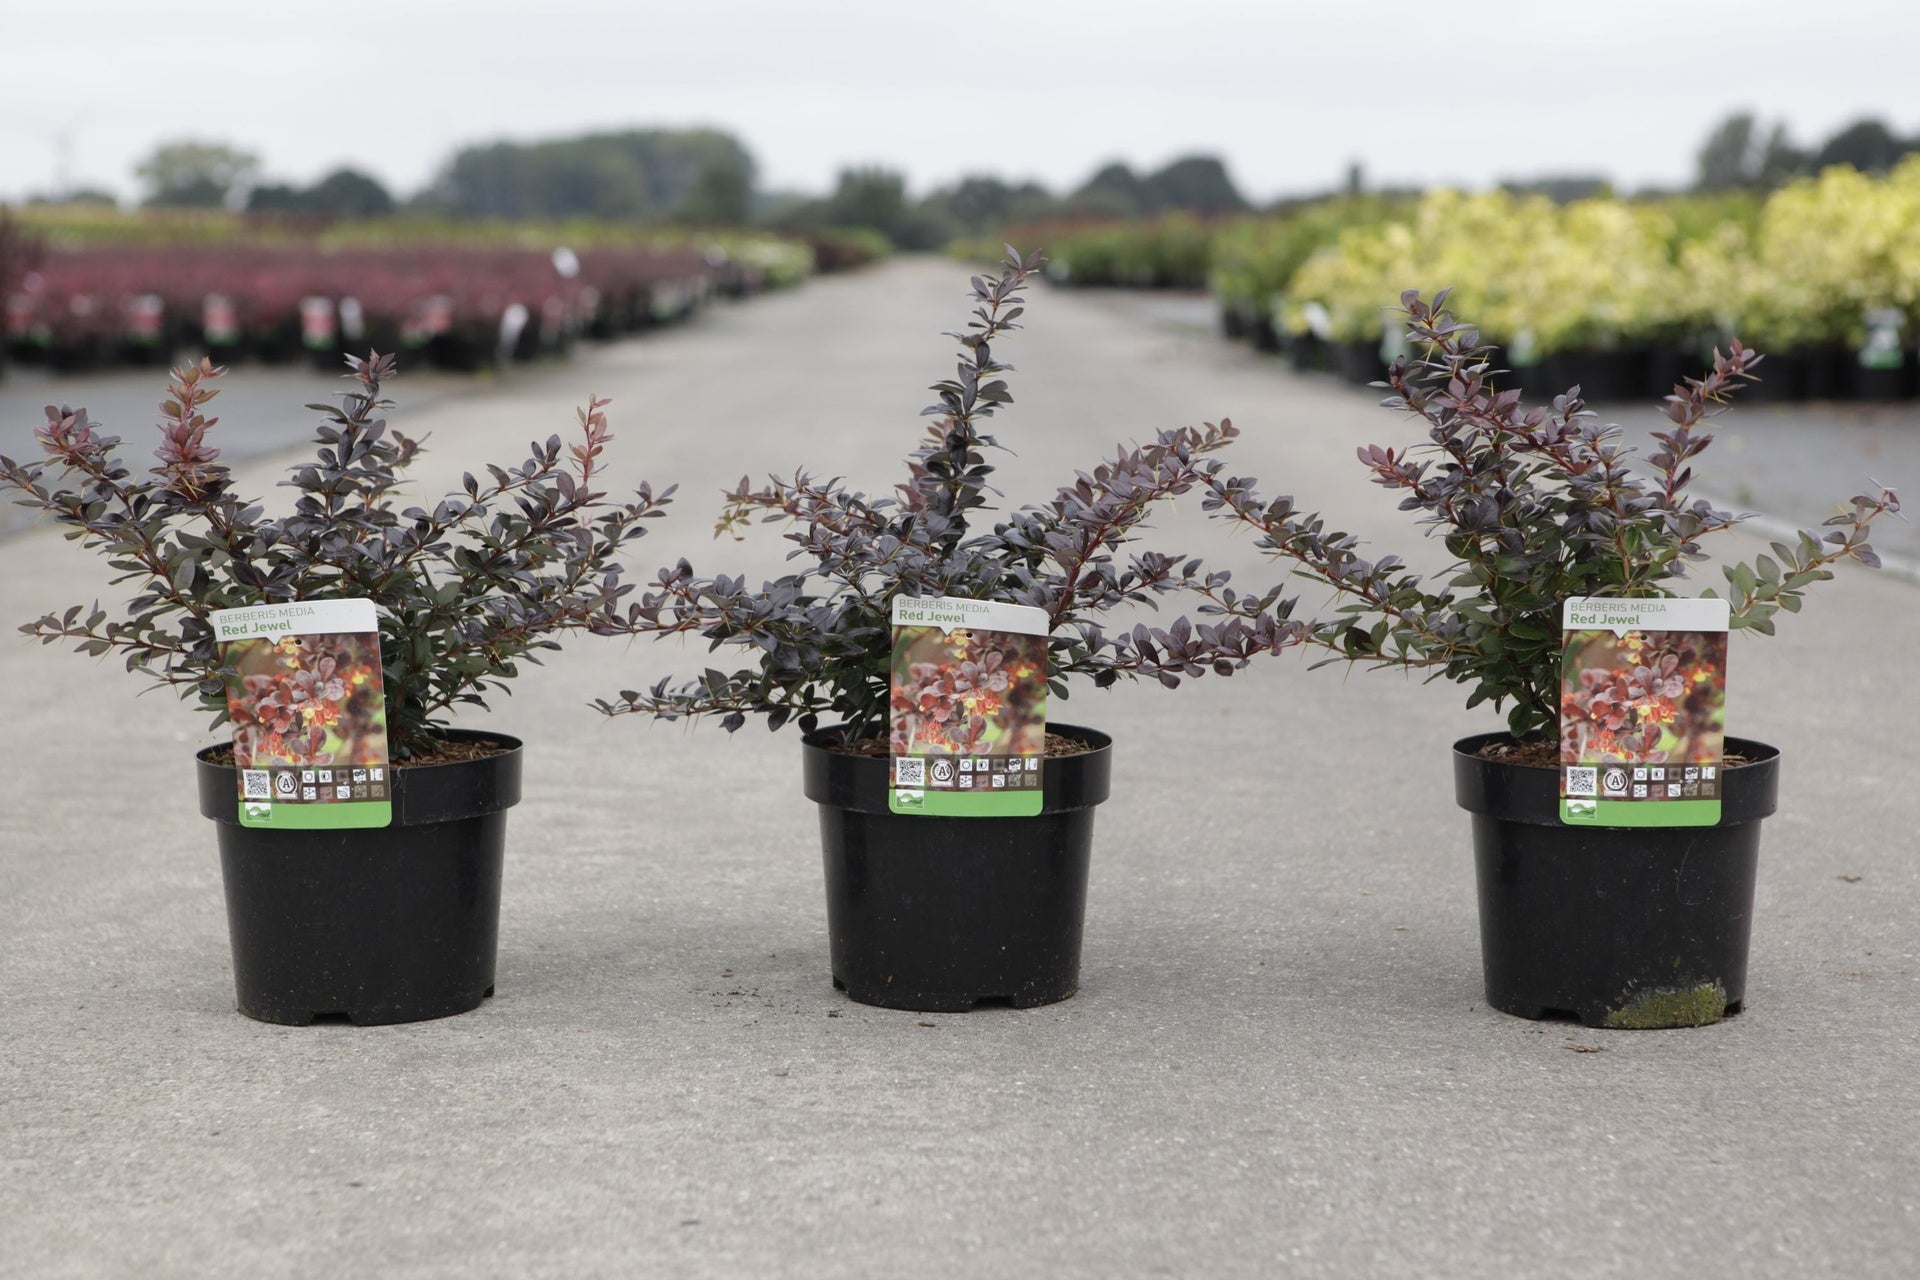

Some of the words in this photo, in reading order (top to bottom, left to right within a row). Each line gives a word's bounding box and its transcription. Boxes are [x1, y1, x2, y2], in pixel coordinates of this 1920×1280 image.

[900, 599, 952, 611] BERBERIS
[956, 603, 991, 614] MEDIA
[1571, 602, 1627, 612] BERBERIS
[1631, 603, 1667, 613] MEDIA
[219, 610, 276, 624] BERBERIS
[279, 607, 315, 617] MEDIA
[899, 609, 924, 621] Red
[927, 611, 966, 623] Jewel
[1570, 613, 1596, 624] Red
[1599, 614, 1640, 625] Jewel
[221, 624, 248, 636] Red
[252, 619, 292, 633] Jewel
